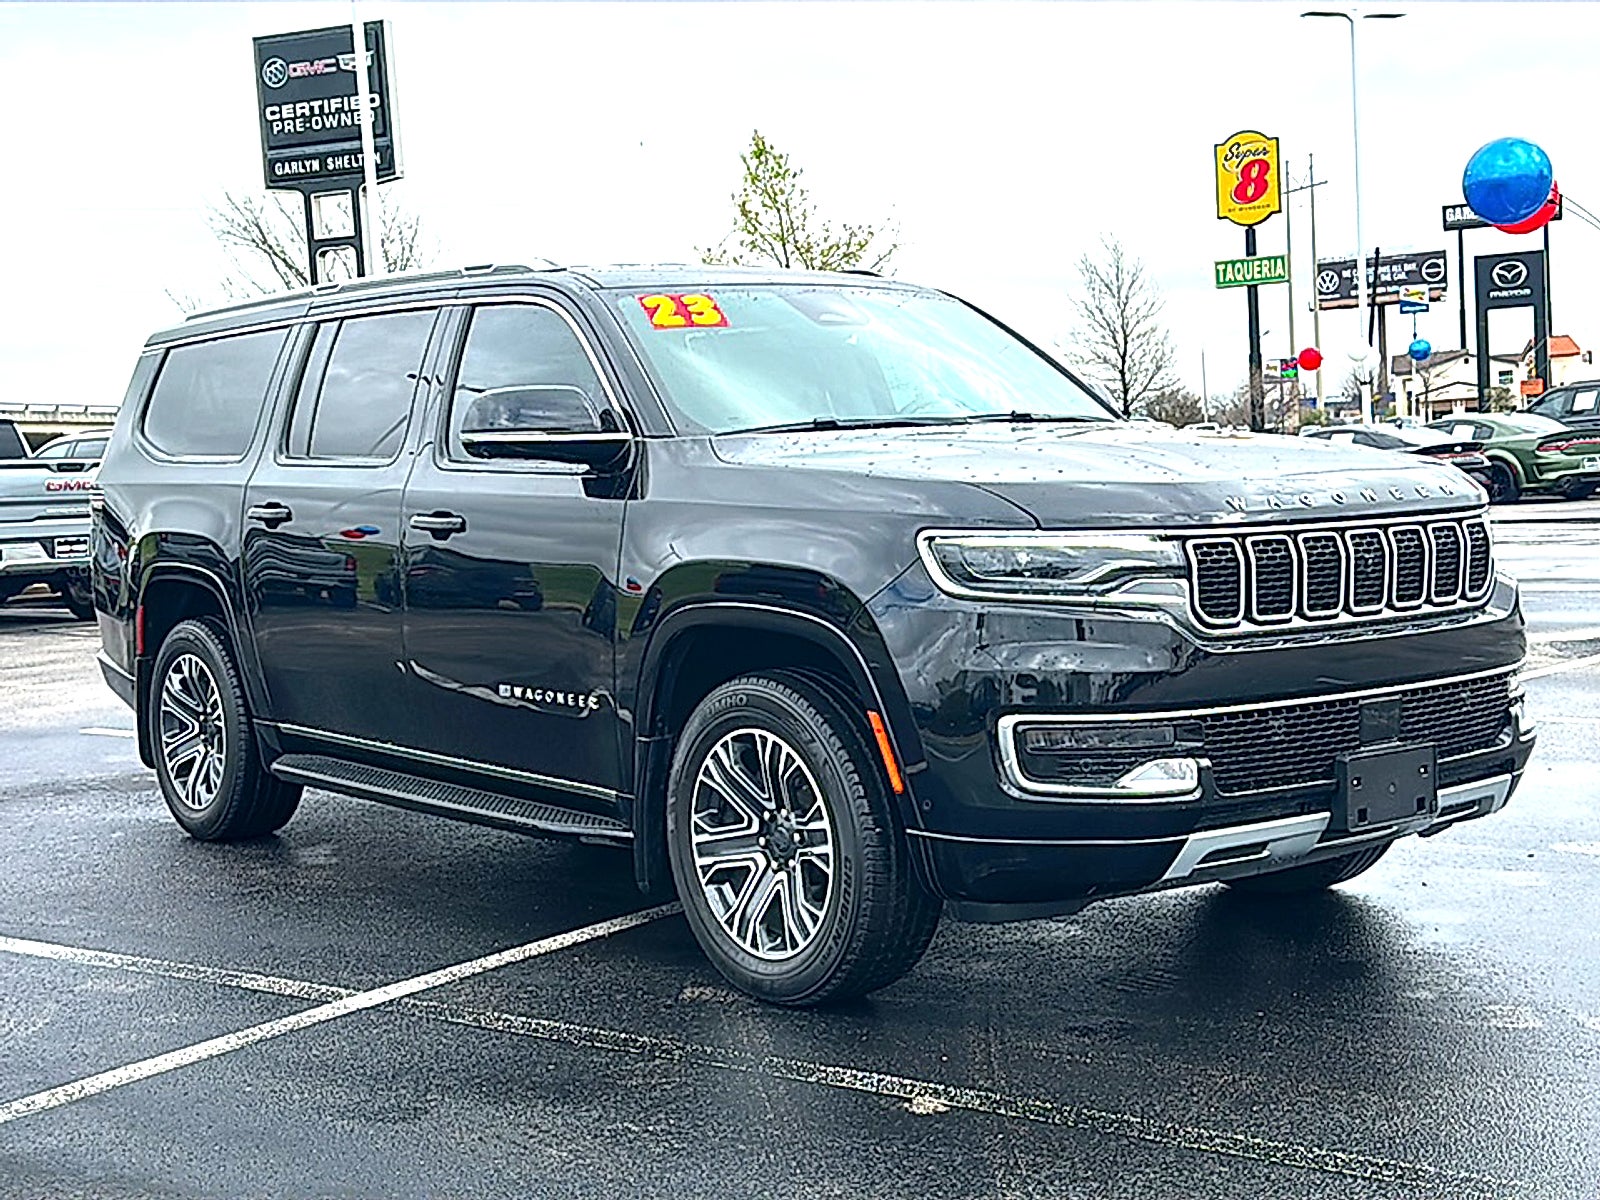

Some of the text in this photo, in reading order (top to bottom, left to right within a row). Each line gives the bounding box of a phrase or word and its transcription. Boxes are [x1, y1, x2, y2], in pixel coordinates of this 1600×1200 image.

[288, 58, 337, 78] GMC
[265, 93, 381, 121] CERTIFIED
[274, 151, 381, 176] GARLYN SHELTN
[1223, 141, 1271, 169] Super
[1232, 158, 1271, 205] 8
[1216, 258, 1284, 283] TAQUERIA
[641, 294, 722, 326] 23
[1224, 484, 1455, 512] WAGONEER
